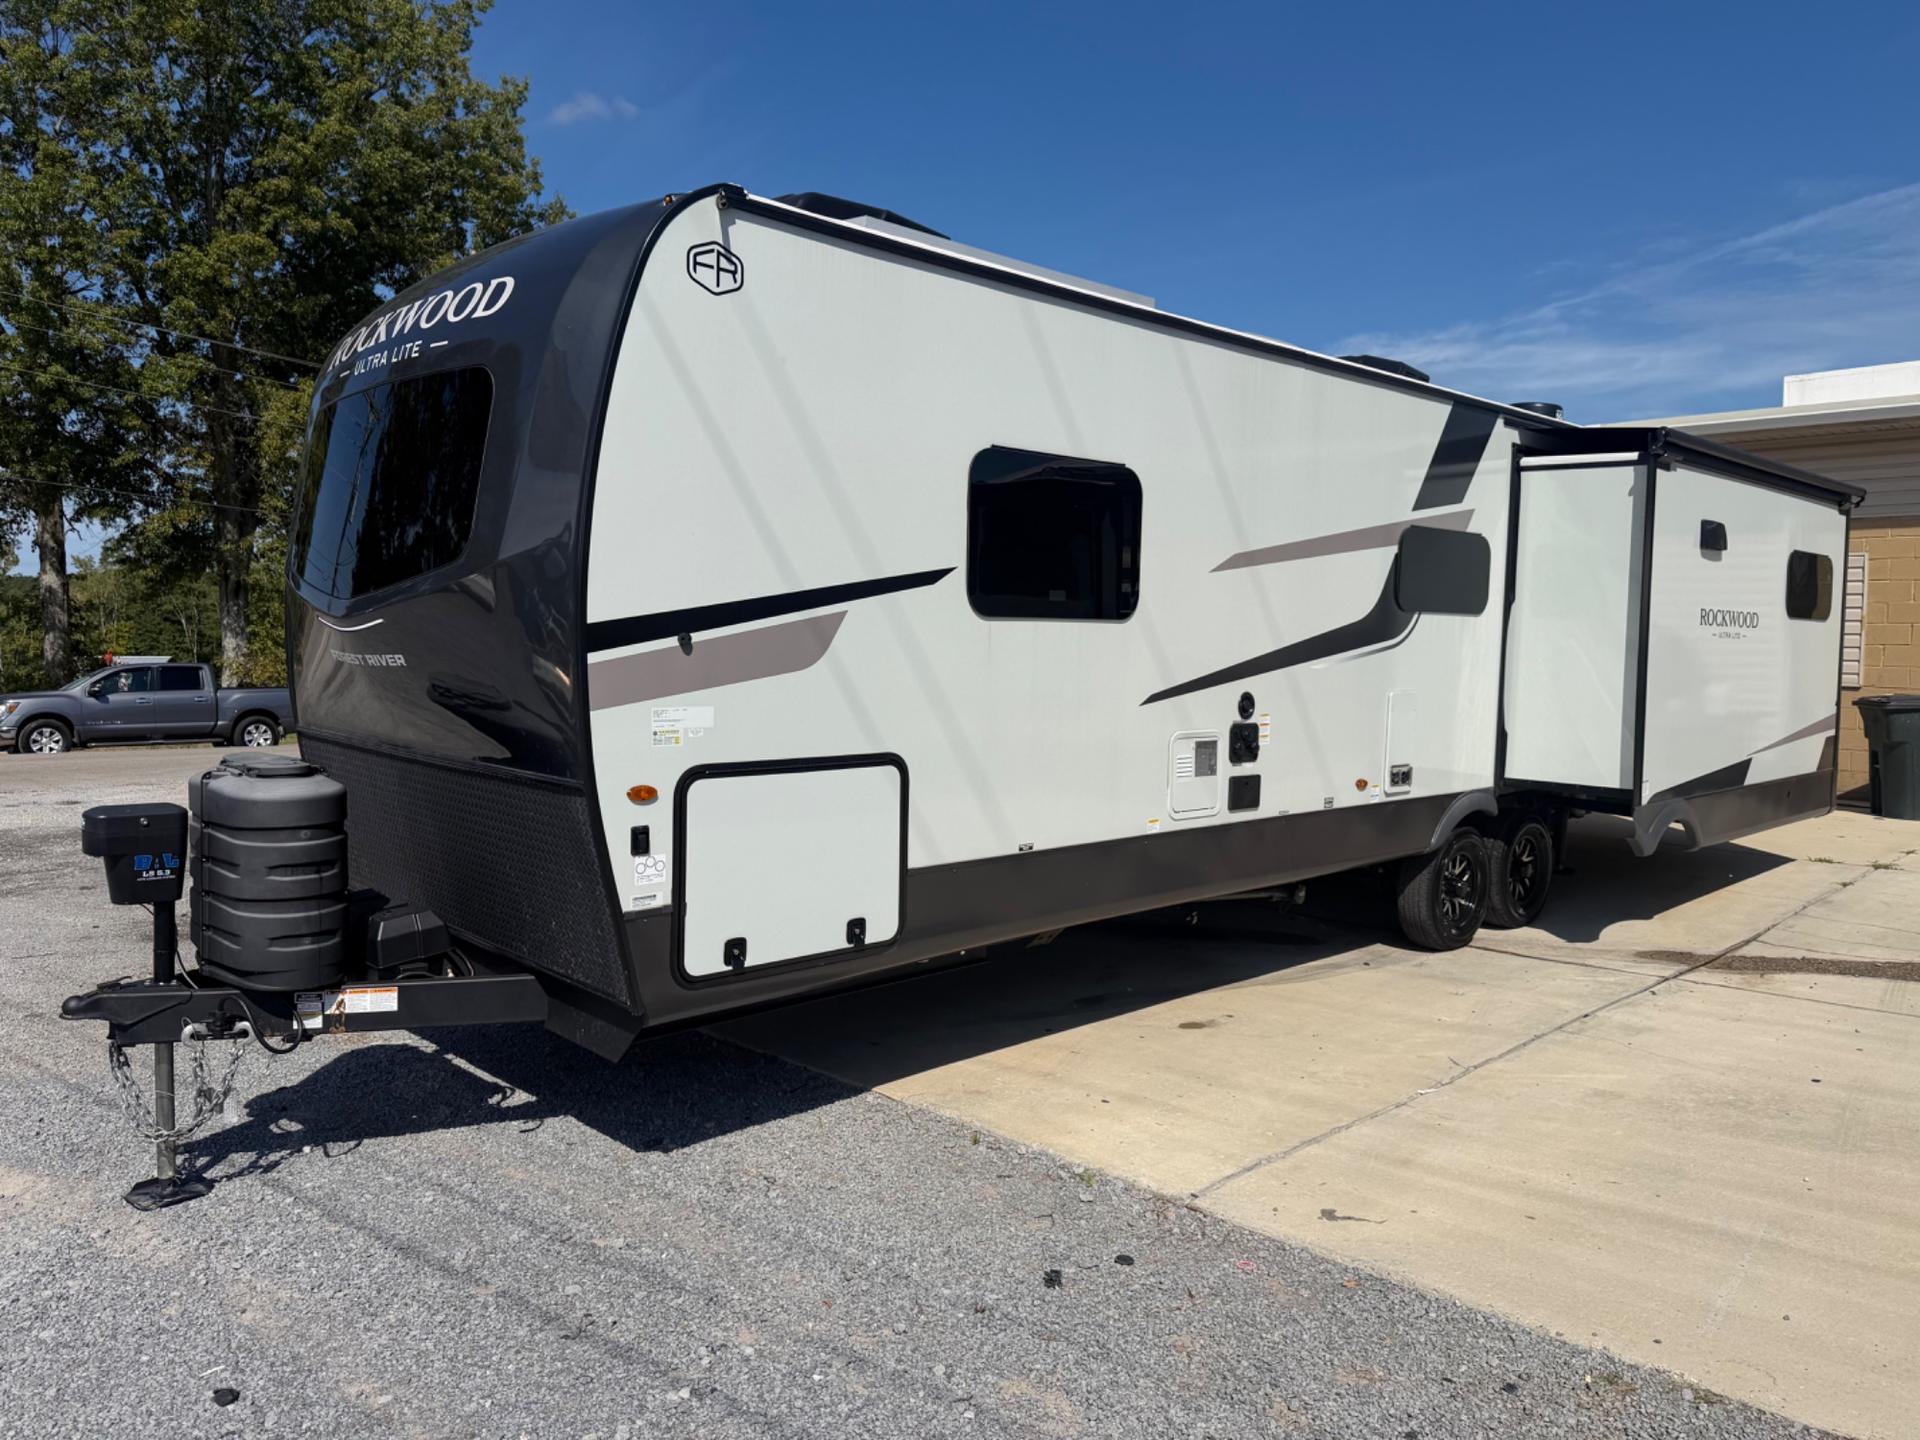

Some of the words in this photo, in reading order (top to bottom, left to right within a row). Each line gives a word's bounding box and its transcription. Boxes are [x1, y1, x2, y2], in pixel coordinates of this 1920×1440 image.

[327, 276, 515, 372] ROCKWOOD
[354, 350, 387, 376] ULTRA
[391, 340, 423, 363] LITE
[1699, 608, 1760, 628] ROCKWOOD
[365, 654, 407, 666] RIVER
